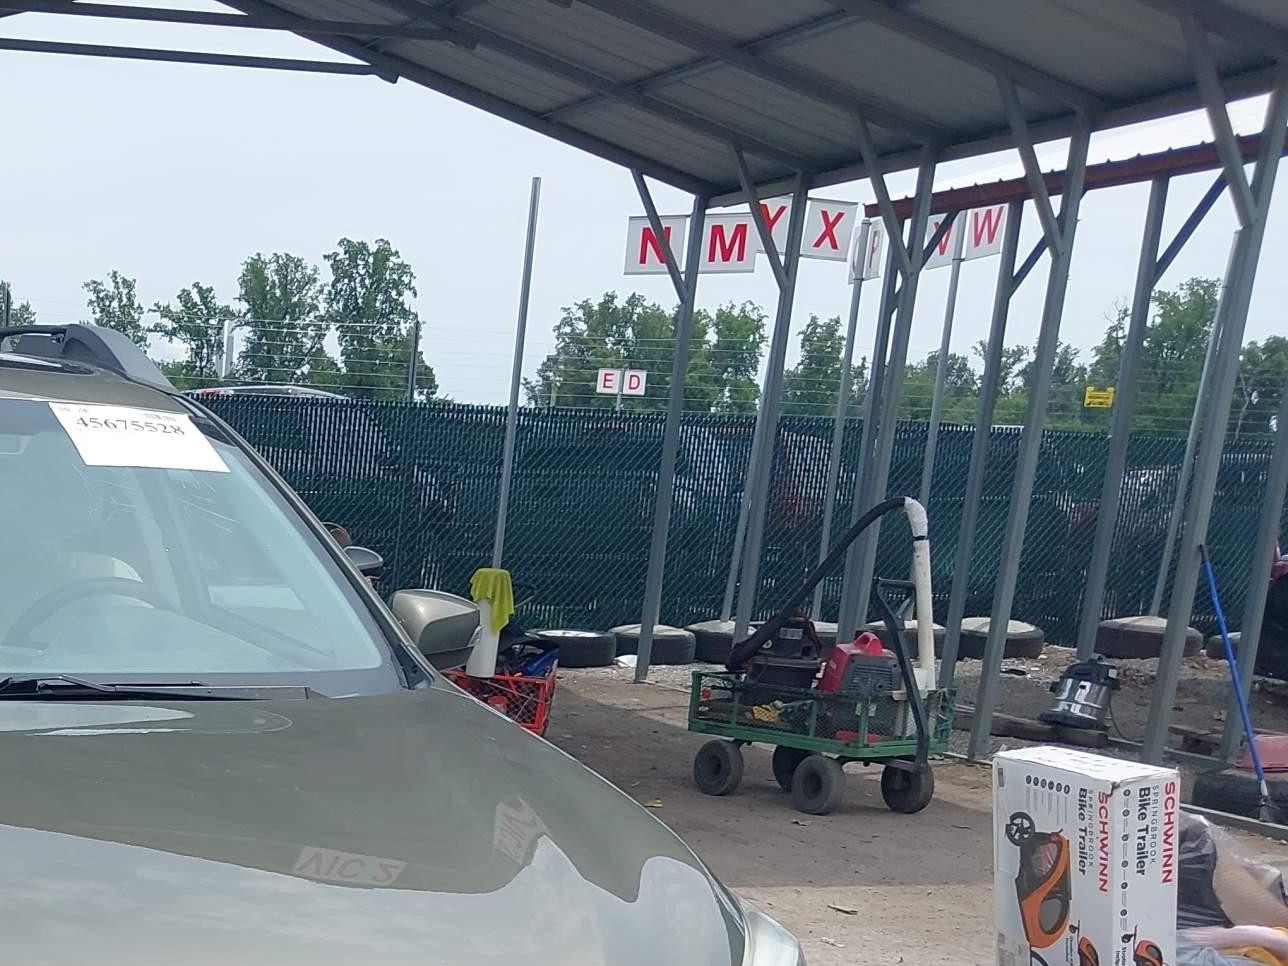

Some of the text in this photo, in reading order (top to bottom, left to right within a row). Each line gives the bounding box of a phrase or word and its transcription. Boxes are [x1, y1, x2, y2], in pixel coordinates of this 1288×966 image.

[639, 223, 748, 265] N M
[813, 210, 846, 250] X
[973, 206, 1005, 248] W
[602, 372, 641, 390] E D
[76, 417, 185, 435] 45675528
[1077, 787, 1088, 876] Bike Trailer
[1096, 791, 1109, 893] SCHWINN
[1136, 787, 1151, 876] Bike Trailer
[1148, 785, 1159, 865] SPRINGBROOK
[1161, 782, 1176, 884] SCHWINN
